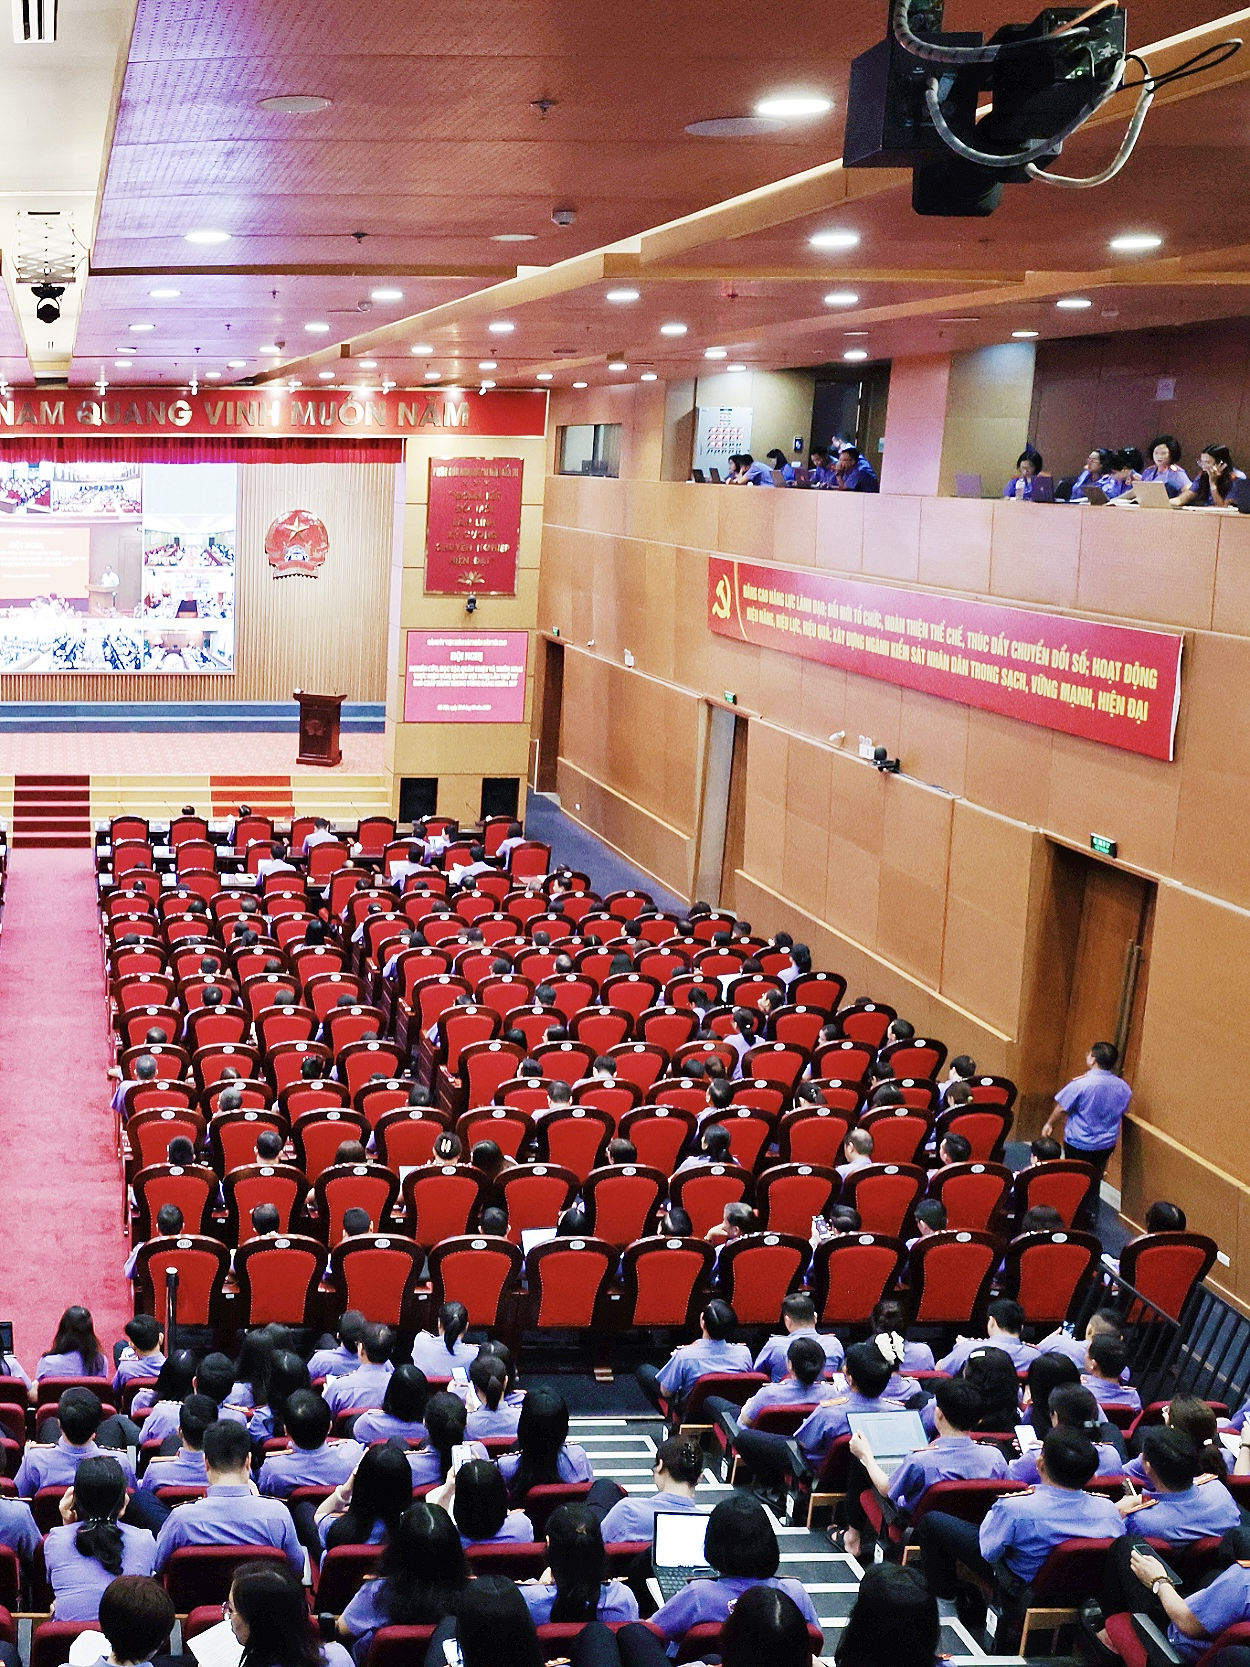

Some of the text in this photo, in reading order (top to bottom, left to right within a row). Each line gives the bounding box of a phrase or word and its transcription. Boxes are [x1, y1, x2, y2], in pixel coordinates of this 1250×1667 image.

[76, 400, 192, 428] QUANG
[204, 400, 280, 427] VINH
[291, 395, 386, 427] MUÔN
[396, 396, 469, 428] NĂM
[884, 612, 905, 634] HOÀN
[906, 618, 929, 641] THIỆN
[967, 630, 990, 653] THÚC
[990, 631, 1010, 657] ĐẨY
[1011, 639, 1050, 666] CHUYỂN
[1051, 644, 1069, 671] ĐỔI
[1092, 657, 1122, 684] HOẠT
[1123, 661, 1158, 690] ĐỘNG
[911, 644, 926, 666] SÁT
[926, 649, 950, 672] NHÂN
[950, 654, 969, 677] DÂN
[970, 660, 1000, 685] TRONG
[1000, 668, 1029, 694] SẠCH,
[1031, 673, 1058, 699] VỮNG
[1060, 682, 1095, 708] MẠNH,
[1098, 690, 1126, 718] HIỆN
[1127, 698, 1149, 724] ĐẠI
